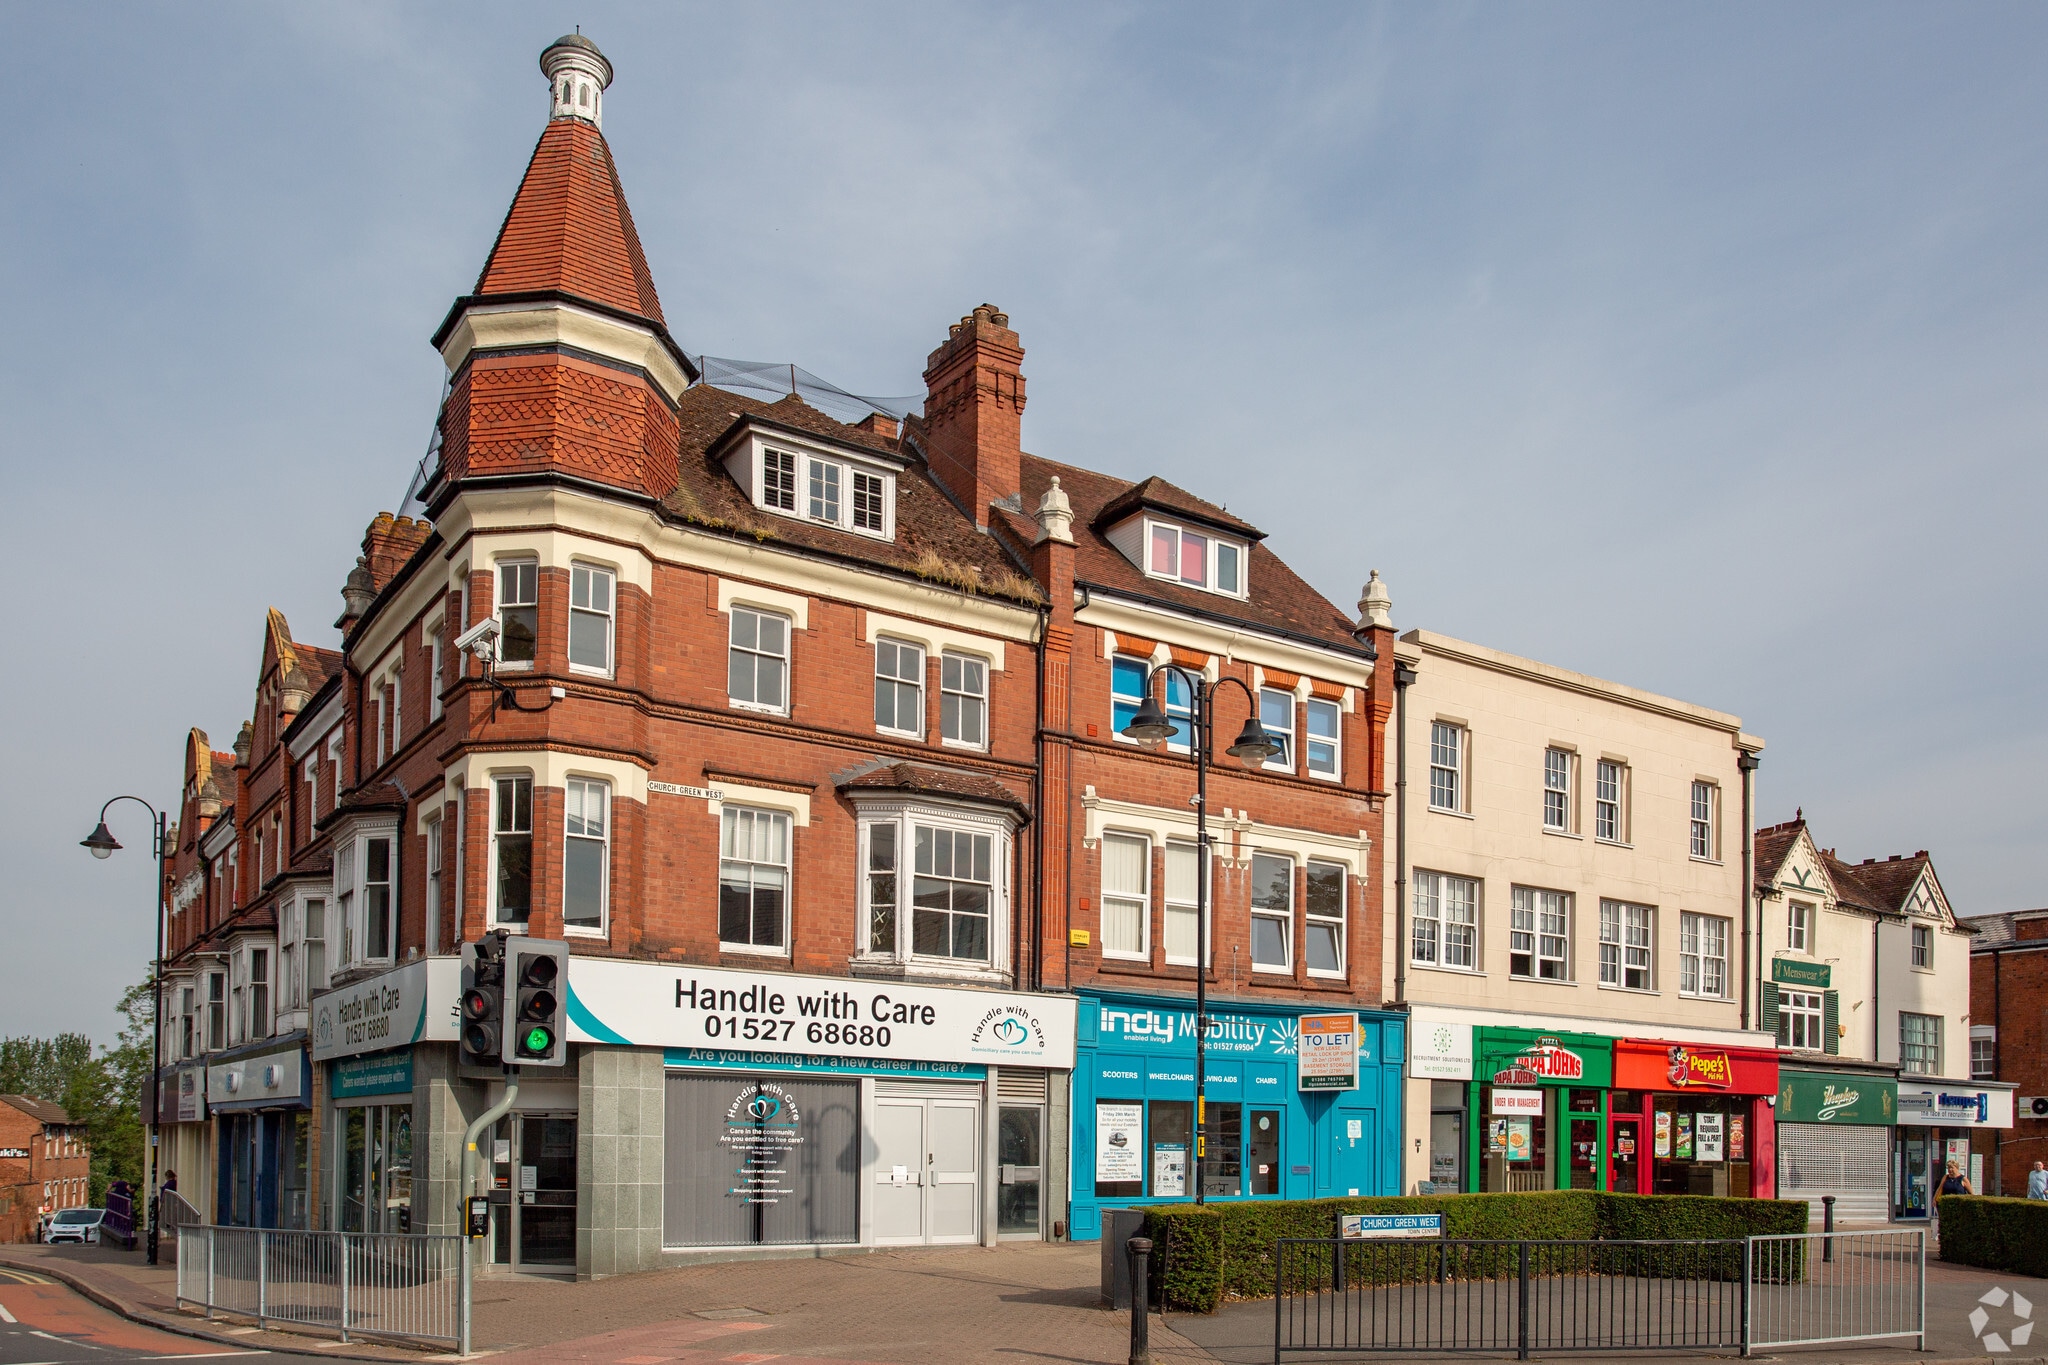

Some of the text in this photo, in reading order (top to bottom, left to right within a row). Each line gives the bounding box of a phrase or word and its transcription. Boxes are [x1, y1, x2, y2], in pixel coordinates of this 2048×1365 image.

[648, 782, 722, 799] CHURCH GREEN WEST
[1783, 966, 1818, 980] Menswear
[338, 994, 362, 1025] Handle
[364, 989, 379, 1016] with
[381, 985, 400, 1012] Care
[675, 978, 936, 1026] Handle with Care
[345, 1021, 366, 1045] 01527
[368, 1015, 390, 1041] 68680
[704, 1015, 892, 1047] 01527 68680
[972, 1006, 1045, 1048] Handle with Care
[1101, 1008, 1174, 1042] indy
[1124, 1034, 1166, 1044] enabled living
[1214, 1042, 1232, 1050] 01527
[1234, 1043, 1254, 1052] 69504
[1304, 1034, 1350, 1046] TO LET
[688, 1049, 966, 1073] Are you looking for a new career in care?
[1547, 1050, 1581, 1076] JOHNS
[1691, 1055, 1724, 1076] Pepe's
[1102, 1070, 1138, 1080] SCOOTERS
[1149, 1072, 1194, 1082] WHEELCHAIRS
[1256, 1077, 1277, 1085] CHAIRS
[1494, 1070, 1537, 1084] PAPA JOHNS
[728, 1084, 799, 1120] Handle with Care
[1494, 1097, 1540, 1108] UNDER NEW MANAGEMENT
[1698, 1134, 1706, 1142] FULL
[1700, 1125, 1719, 1134] REQUIRED
[1363, 1218, 1438, 1228] CHURCH GREEN WEST
